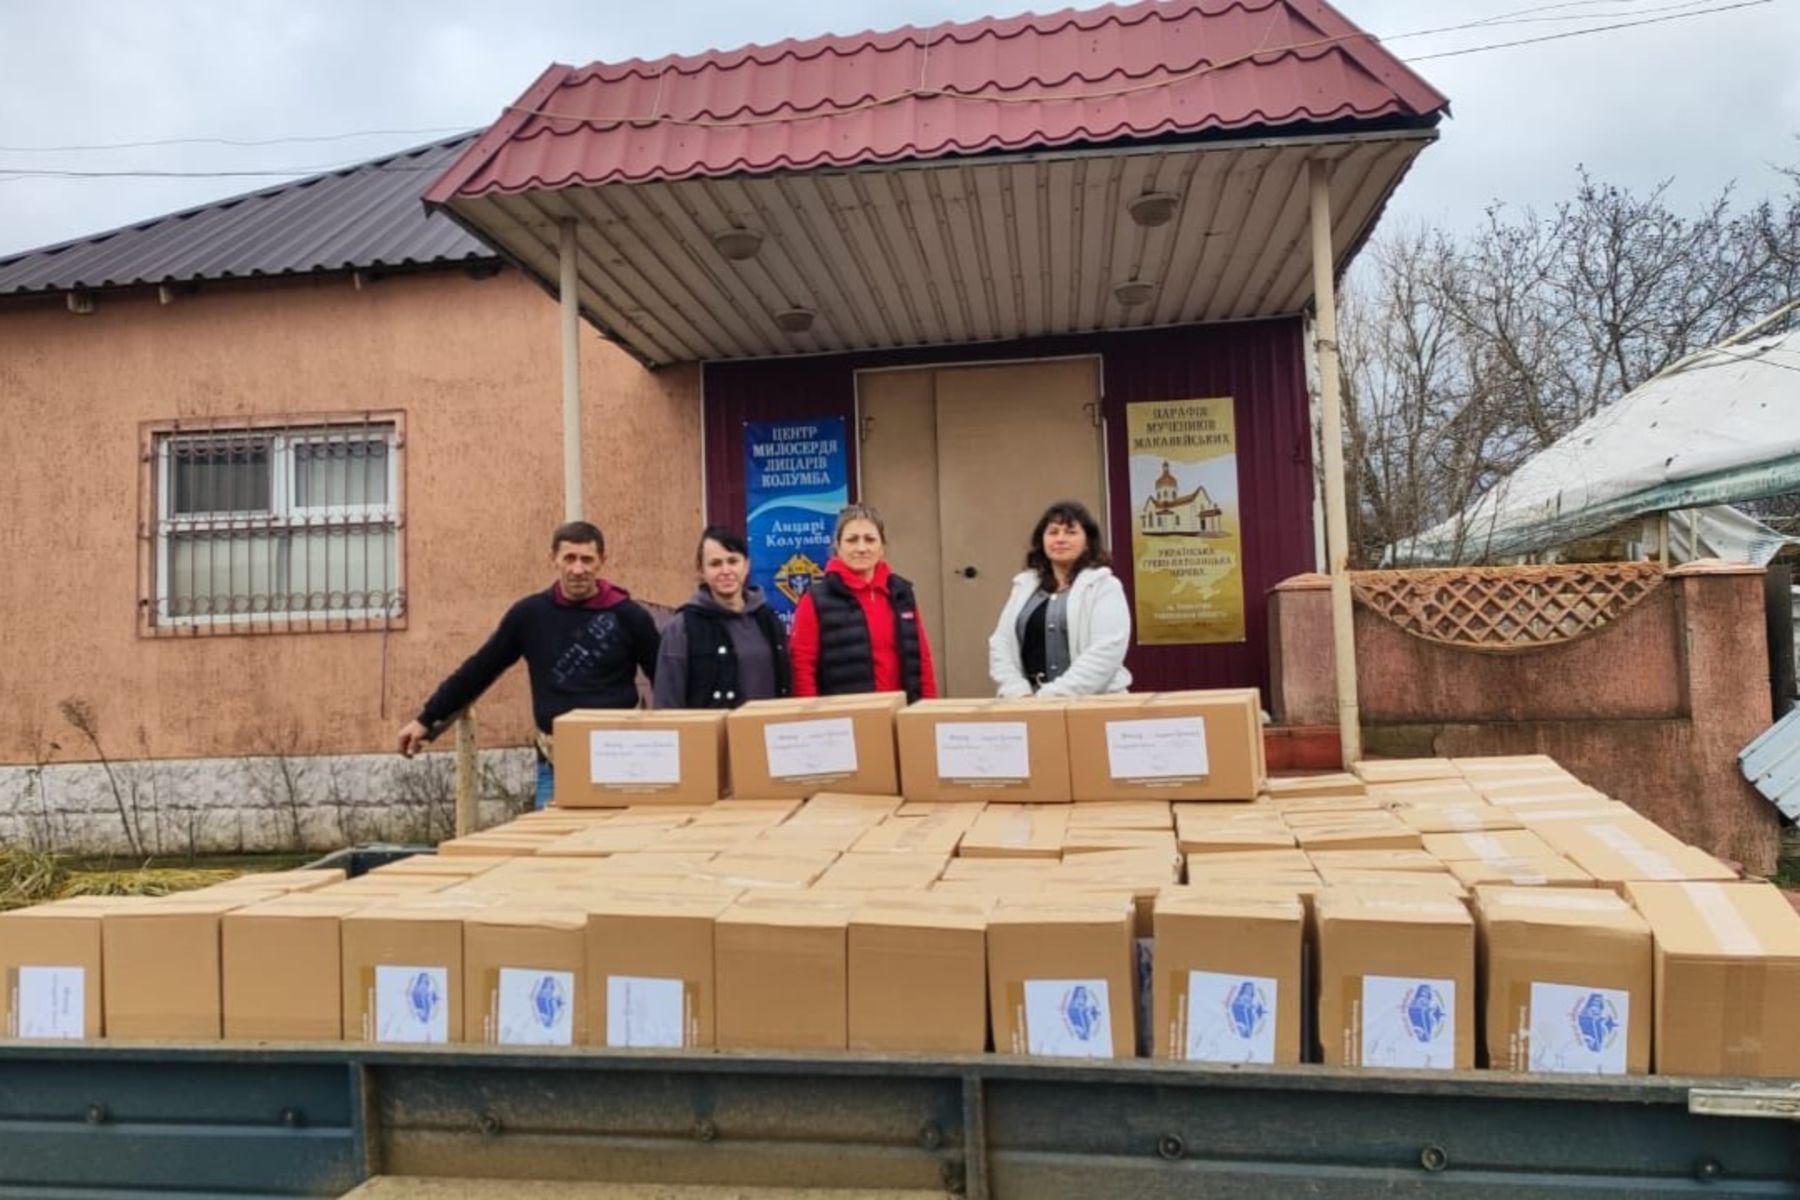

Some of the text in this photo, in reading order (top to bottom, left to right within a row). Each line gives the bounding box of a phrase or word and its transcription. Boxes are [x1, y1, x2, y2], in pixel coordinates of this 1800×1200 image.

[1152, 407, 1208, 419] ПАРАФІЯ
[772, 426, 818, 441] ЦЕНТР
[764, 456, 828, 473] ЛИЦАРІВ
[762, 471, 831, 488] КОЛУМБА
[772, 517, 825, 535] Лицарі
[765, 532, 831, 549] Колумба
